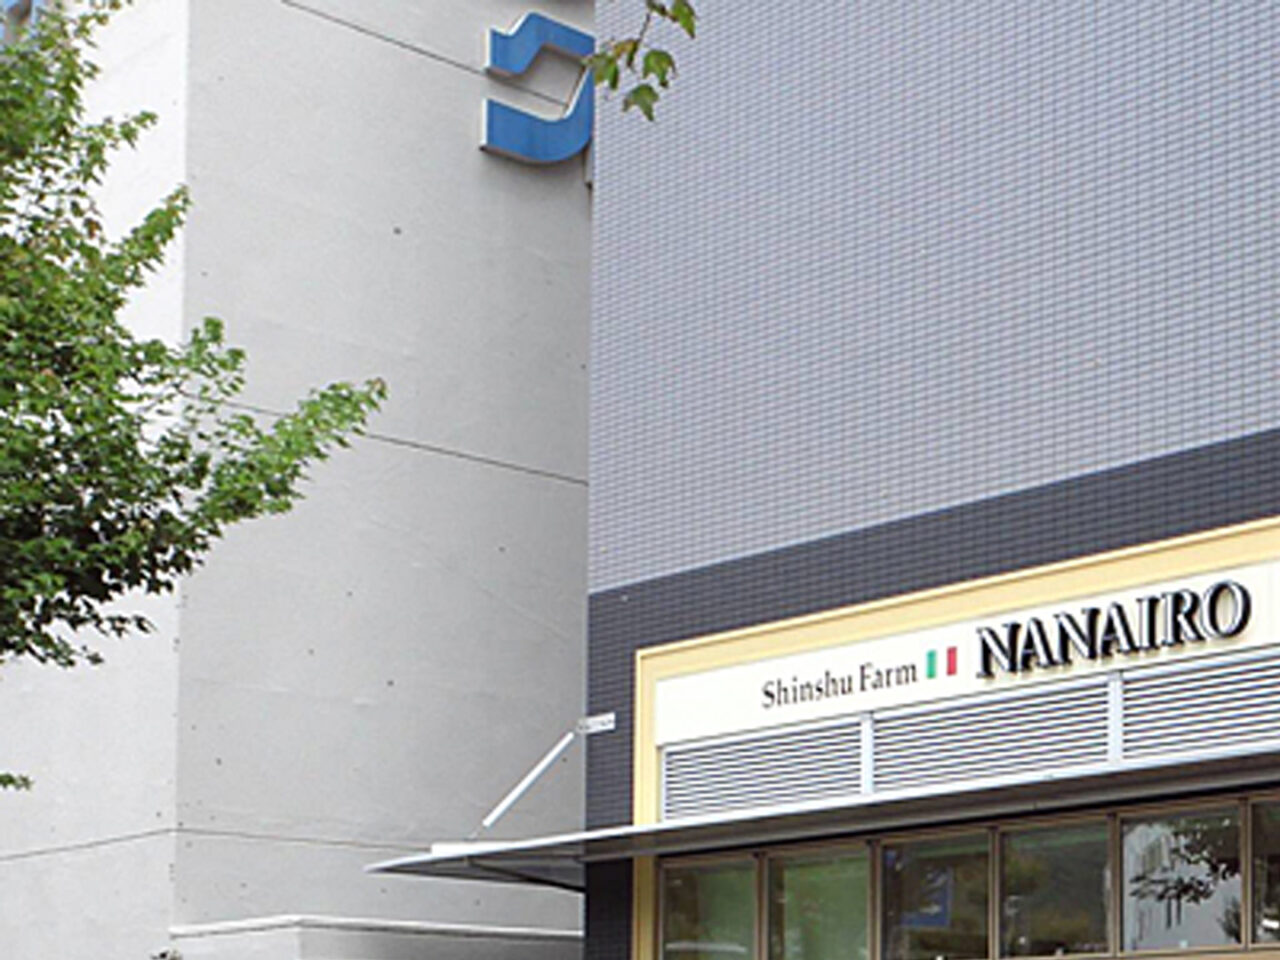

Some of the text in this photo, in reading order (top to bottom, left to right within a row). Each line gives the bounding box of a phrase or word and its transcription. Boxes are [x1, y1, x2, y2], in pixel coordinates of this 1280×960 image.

[976, 580, 1252, 680] NANAIRO
[761, 660, 918, 709] Shinshu Farm
